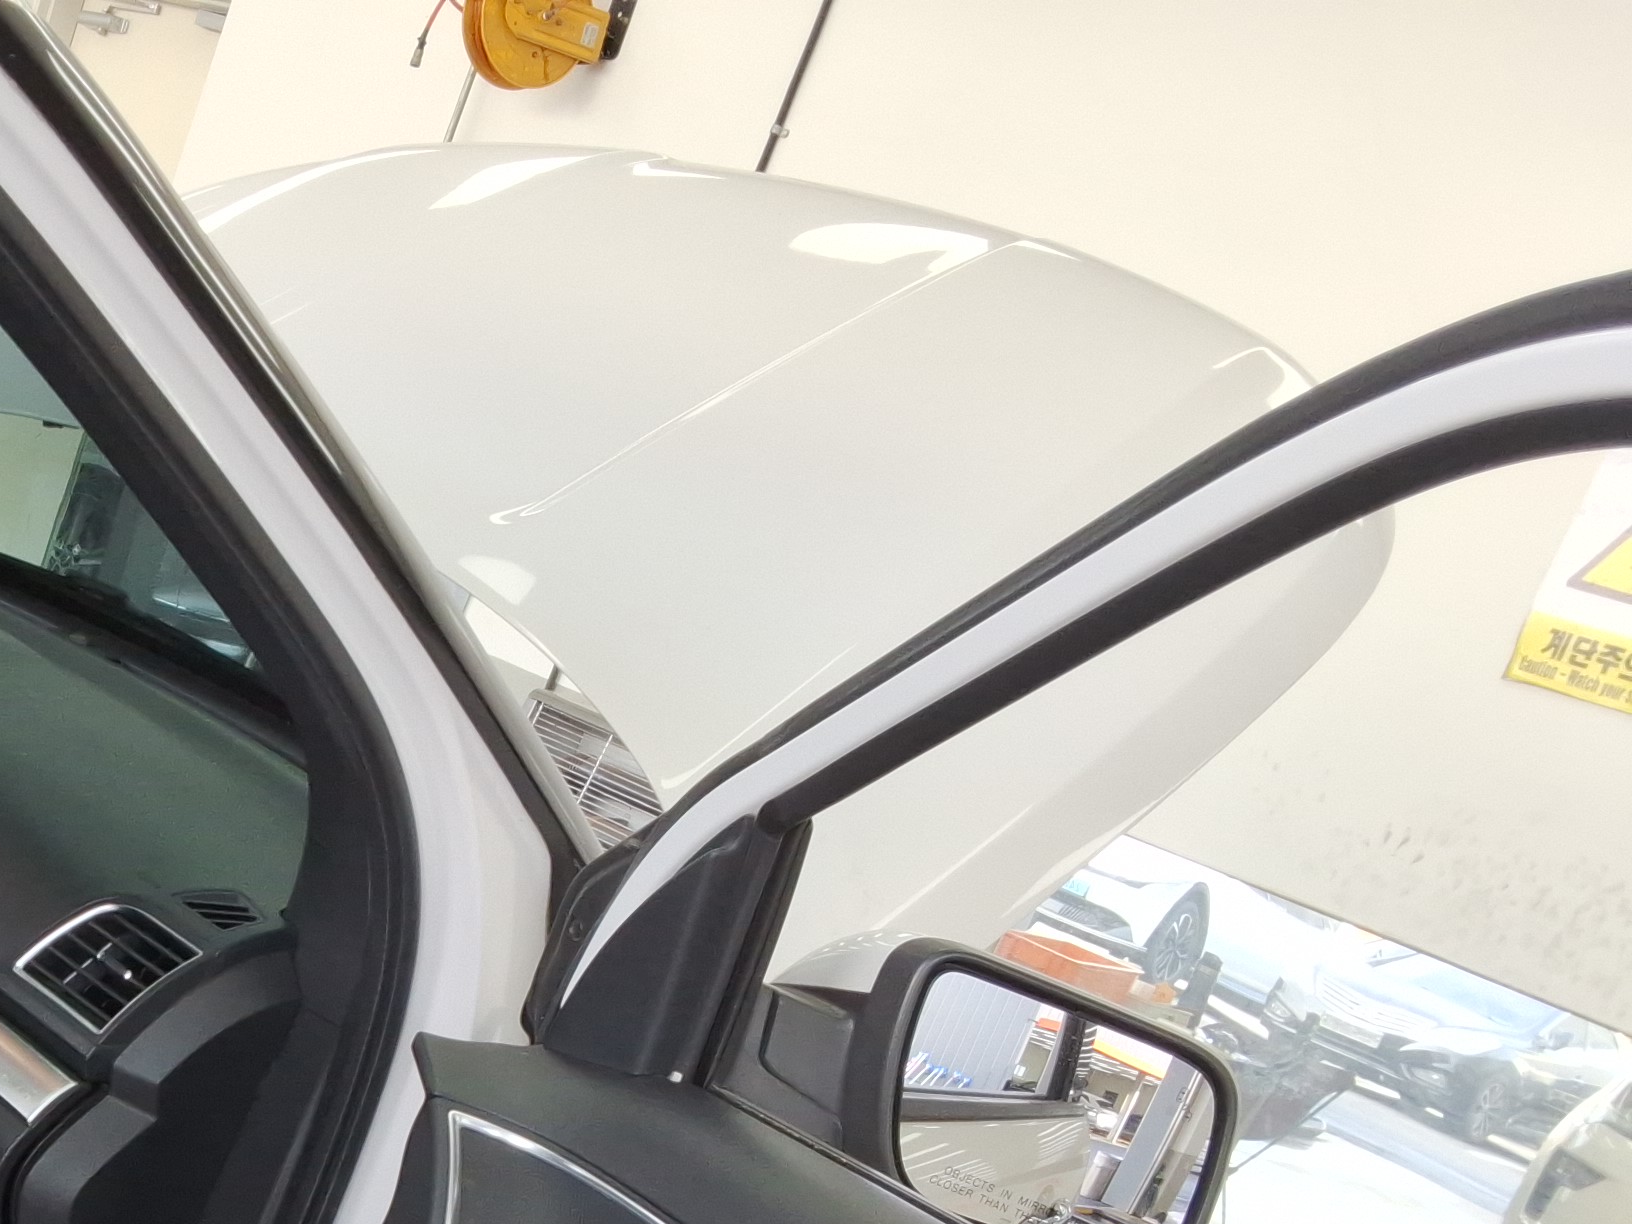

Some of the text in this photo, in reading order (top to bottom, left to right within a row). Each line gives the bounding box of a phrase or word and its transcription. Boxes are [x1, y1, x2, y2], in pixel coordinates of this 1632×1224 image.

[1518, 655, 1558, 680] Caution
[1567, 669, 1600, 693] Watch
[929, 1174, 974, 1198] CLOSER
[979, 1193, 1009, 1213] THAN
[944, 1166, 996, 1193] OBJECTS
[1000, 1188, 1013, 1201] IN
